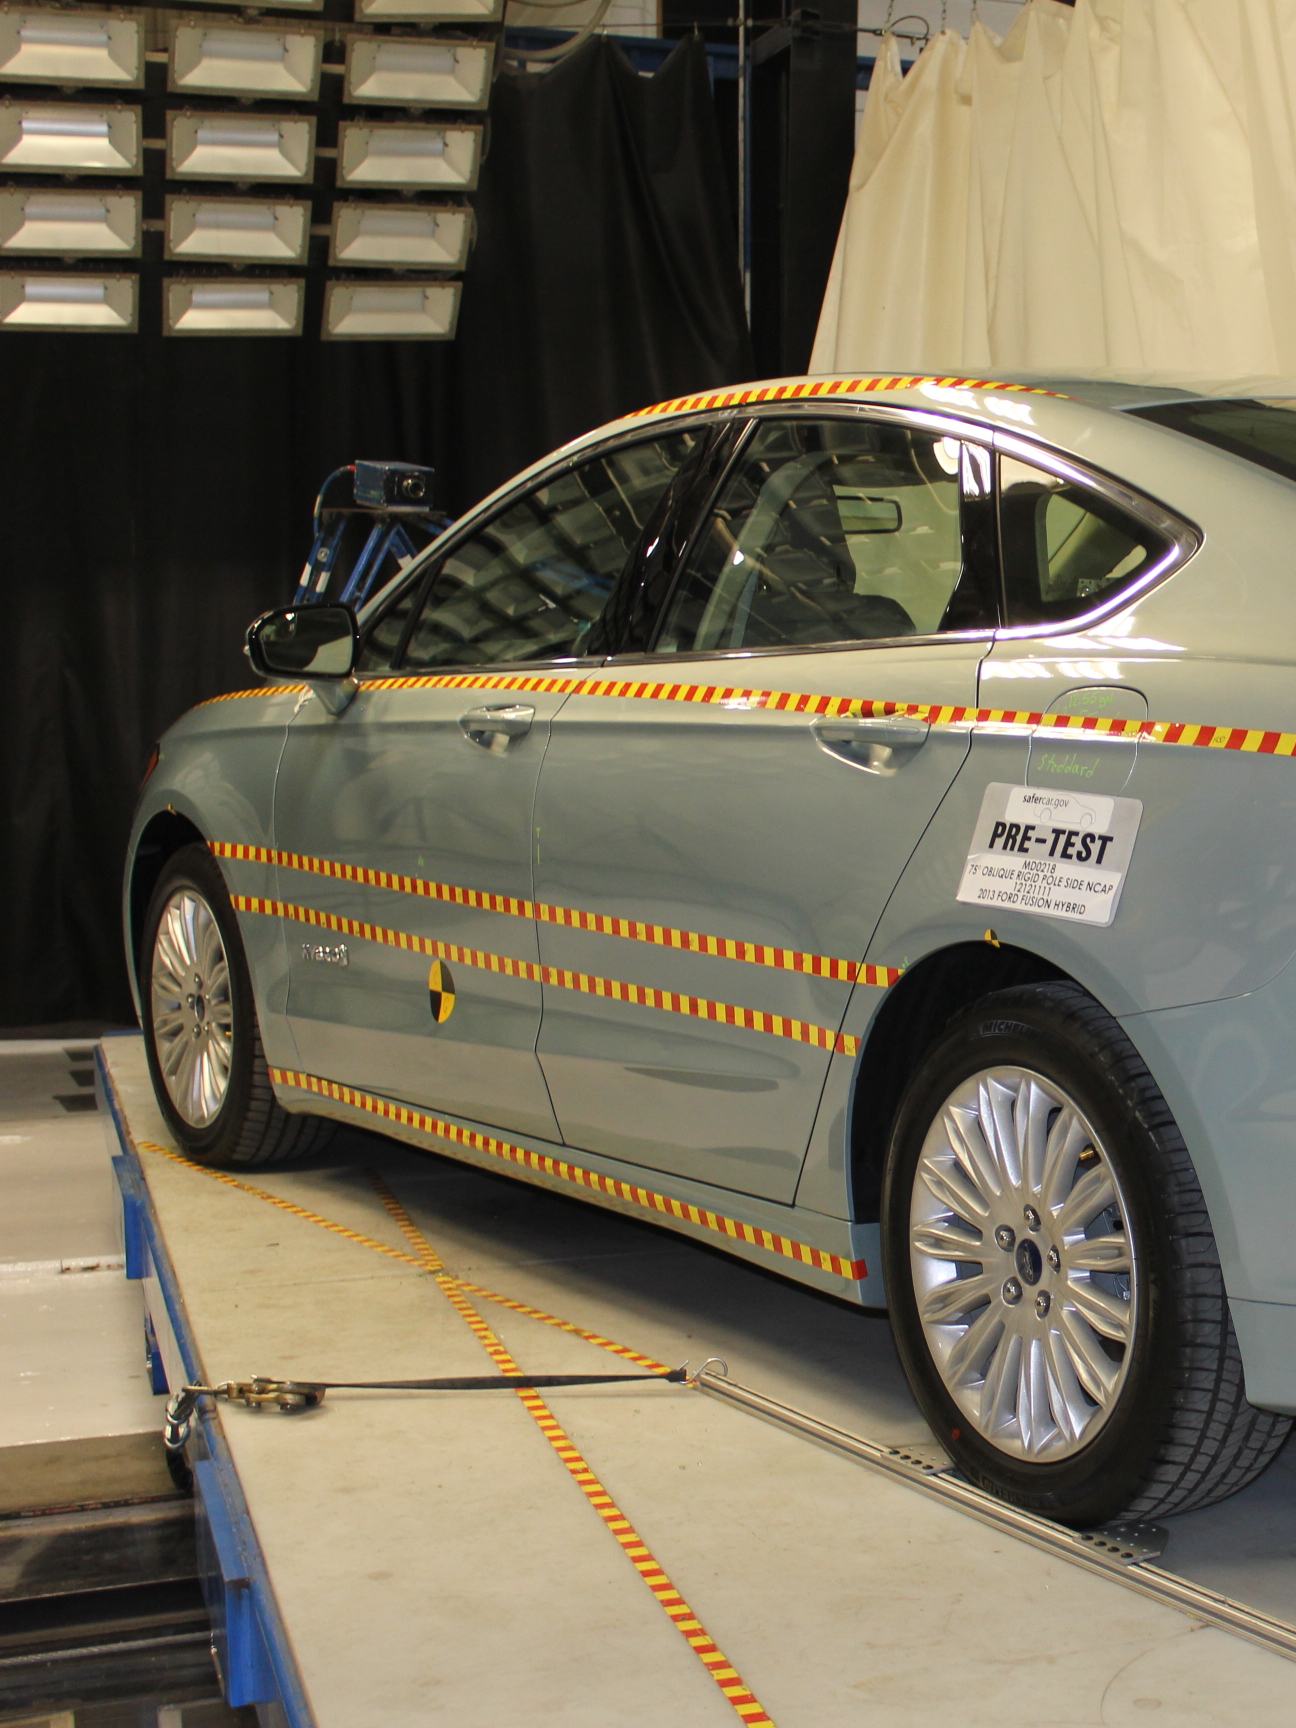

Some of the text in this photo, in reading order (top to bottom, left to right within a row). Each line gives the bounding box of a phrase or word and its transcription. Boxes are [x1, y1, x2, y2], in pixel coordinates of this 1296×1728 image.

[1022, 793, 1070, 808] safercar.gov
[988, 821, 1114, 865] PRE-TEST
[1021, 860, 1057, 874] MD0218
[981, 866, 1015, 881] OBLIQUE
[1016, 870, 1039, 883] RIGID
[1041, 874, 1063, 887] POLE
[1065, 878, 1084, 891] SIDE
[1085, 880, 1114, 895] NCAP
[1013, 882, 1052, 897] 12121111
[977, 888, 1086, 915] 2013 FORD FUSION HYBRID
